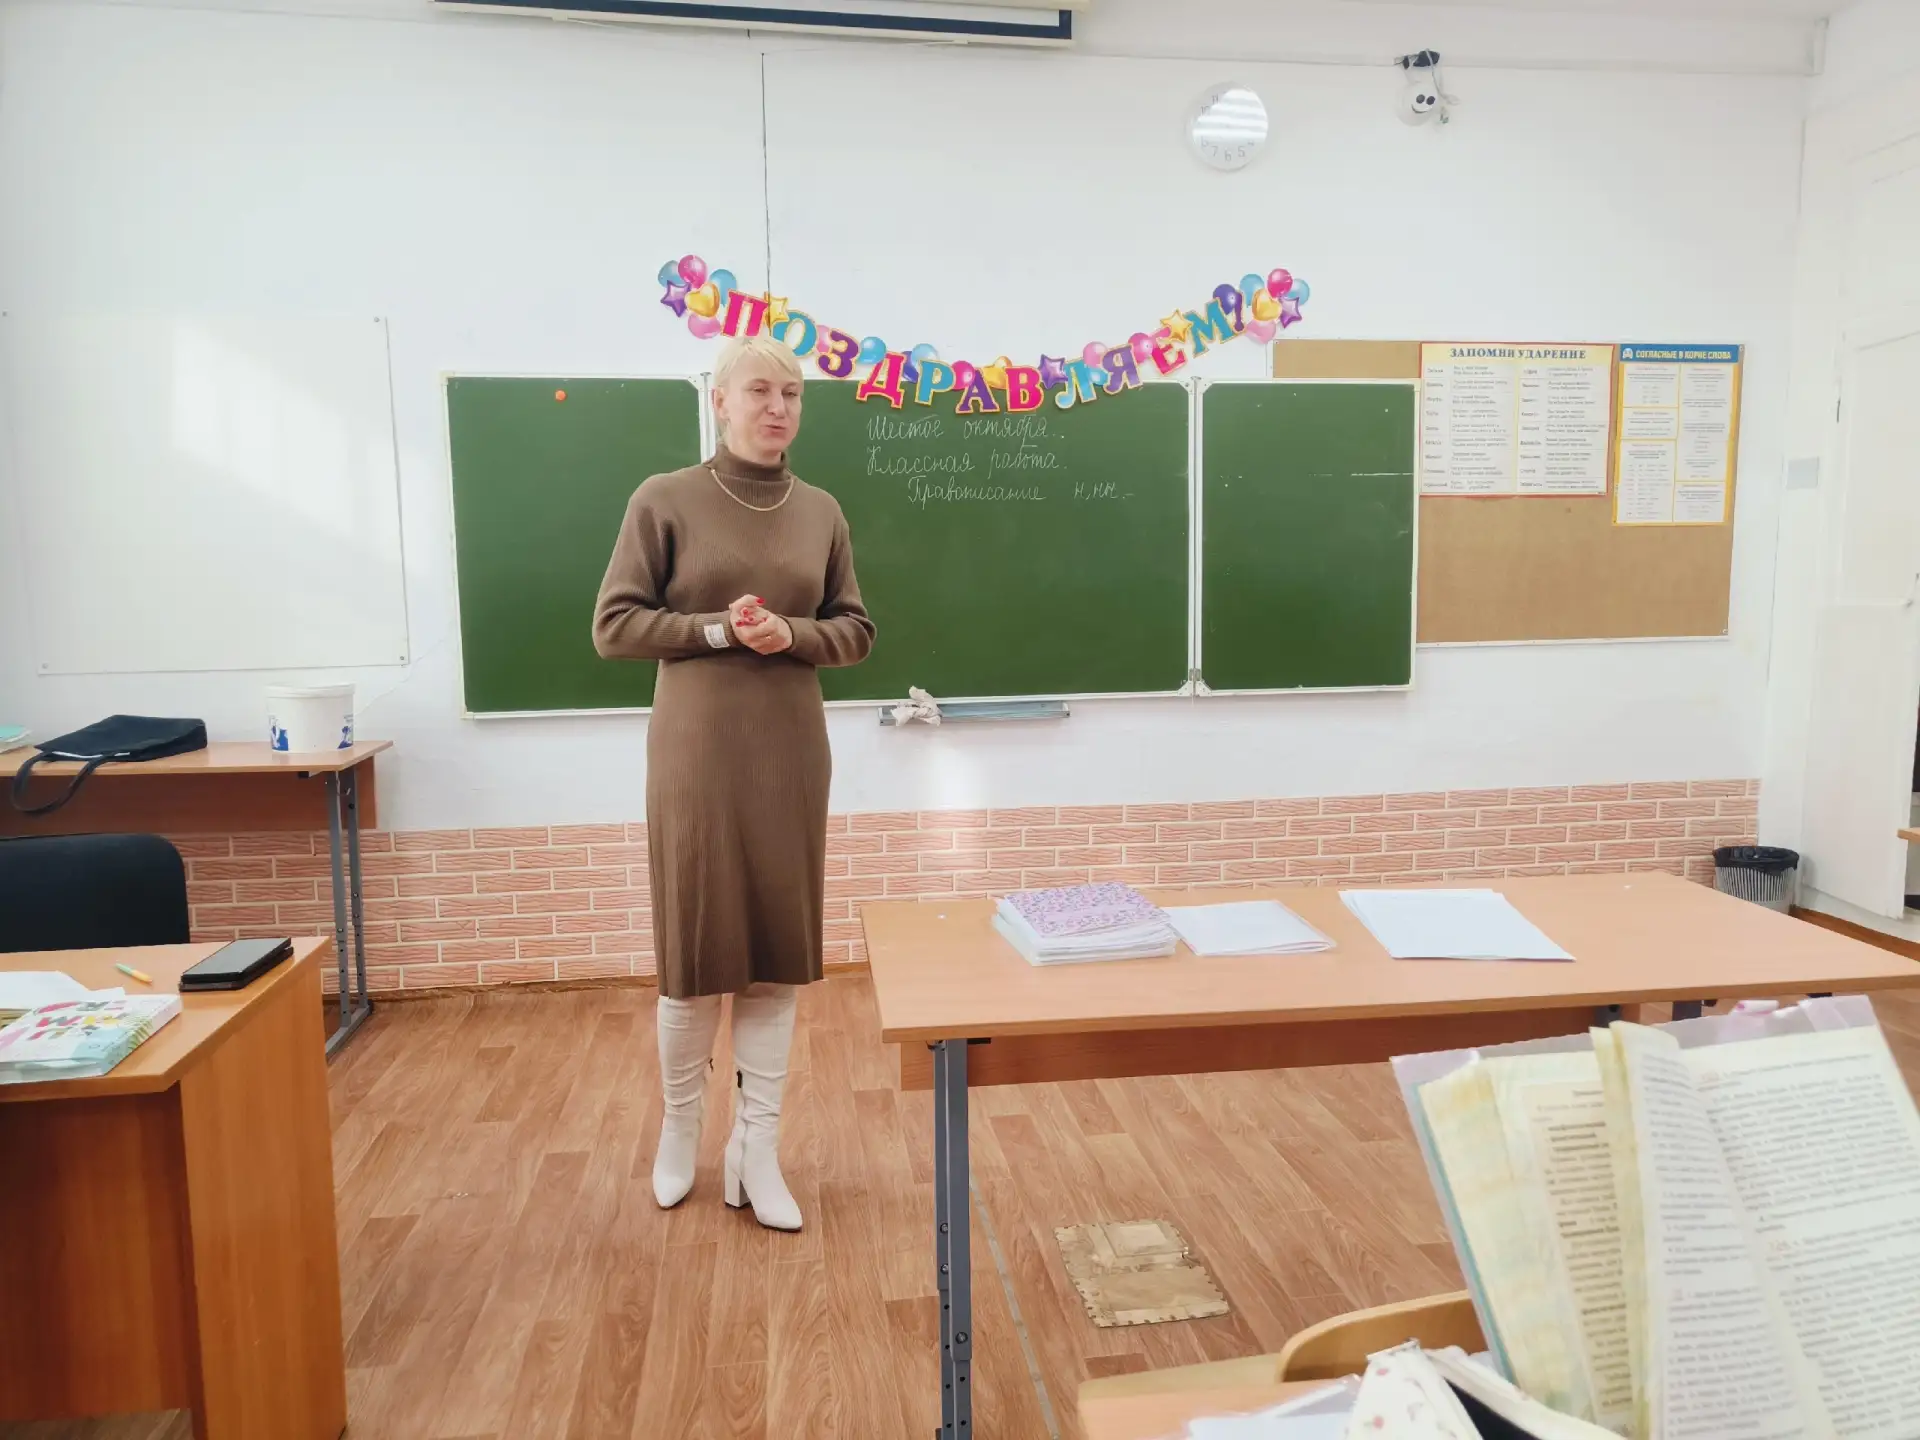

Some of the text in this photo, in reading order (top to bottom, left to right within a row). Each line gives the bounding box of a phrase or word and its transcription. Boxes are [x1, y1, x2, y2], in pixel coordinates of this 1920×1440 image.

[720, 289, 1245, 414] ПОЗДРАВЛЯЕМ!
[1450, 347, 1587, 359] ЗАПОМНИ УДАРЕНИЕ
[1635, 349, 1677, 359] СОГЛАСНЫЕ
[1684, 350, 1707, 359] КОРНЕ
[1708, 351, 1732, 359] СЛОВА
[866, 414, 945, 440] Шестое
[866, 444, 976, 476] Классная
[907, 475, 1047, 510] Правописание
